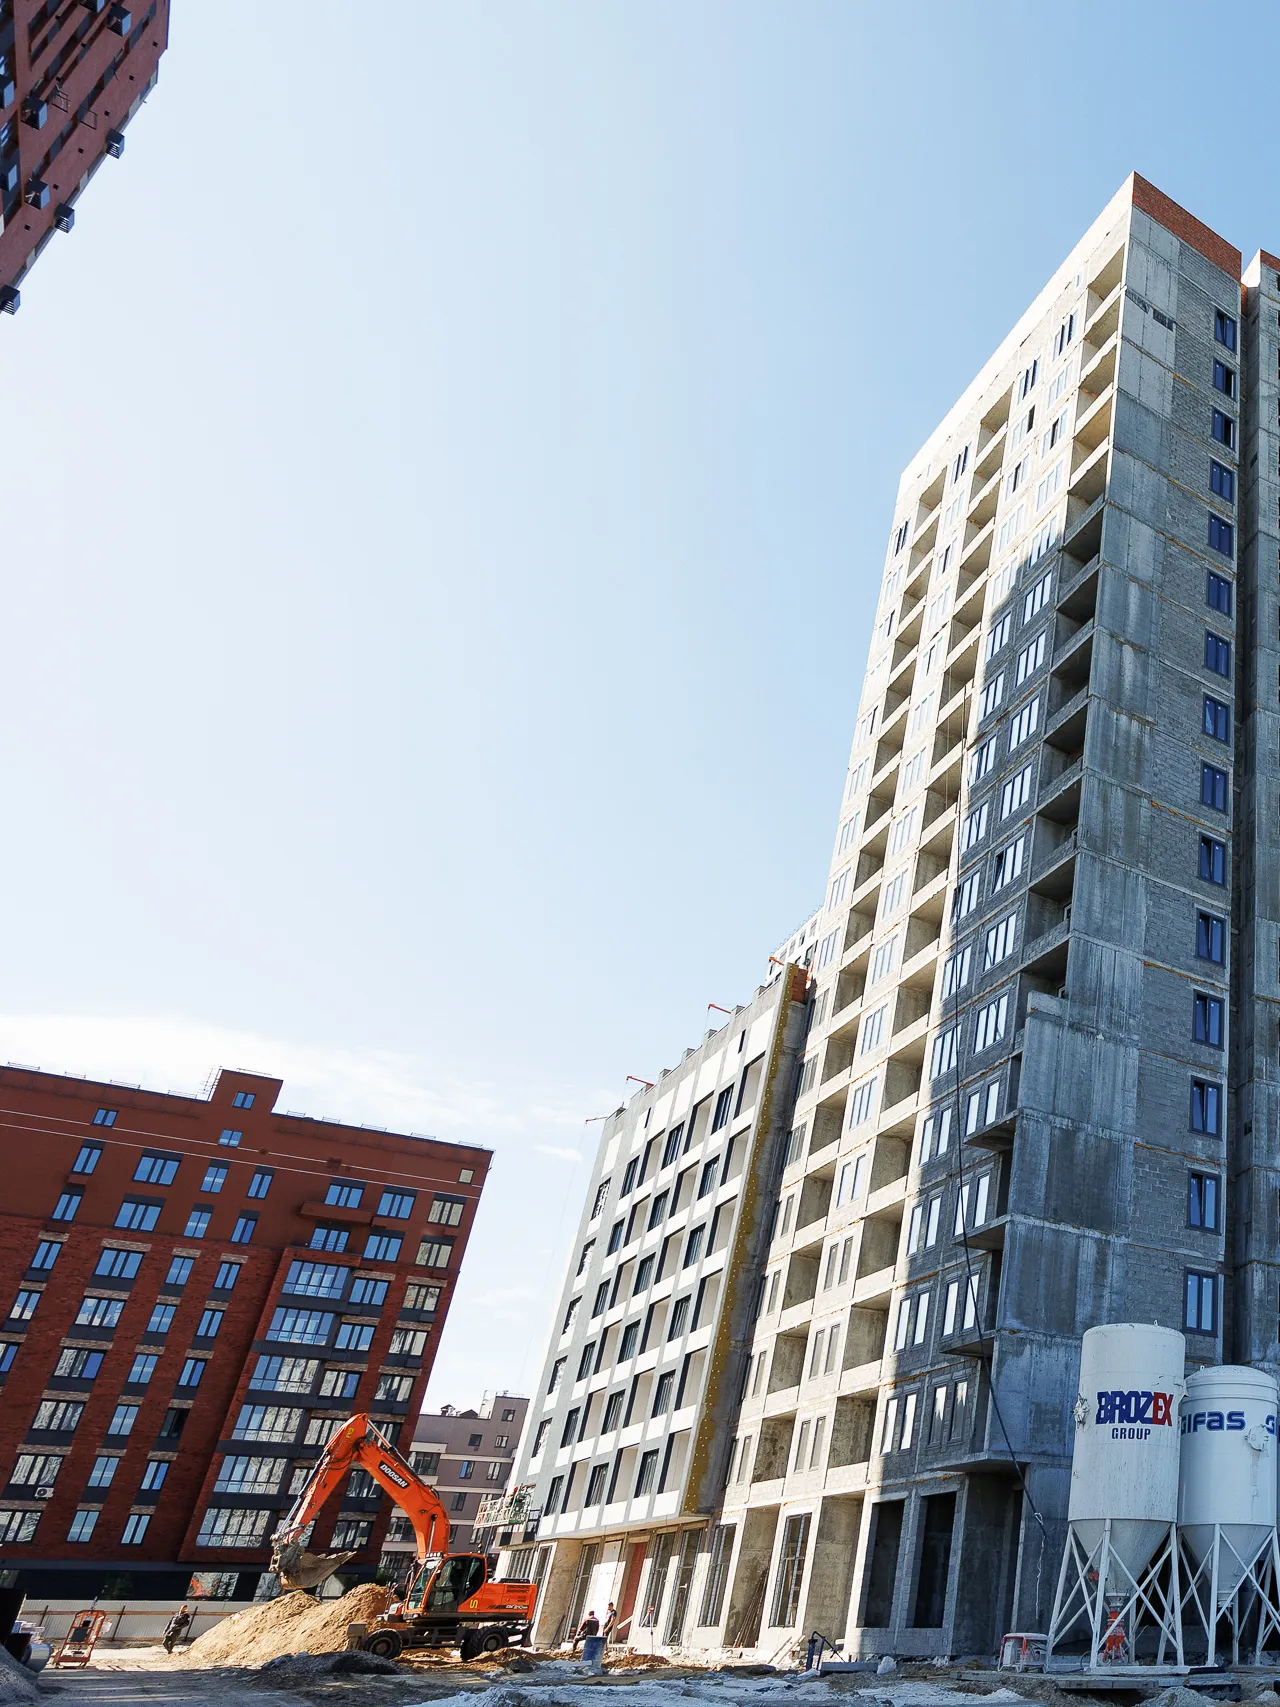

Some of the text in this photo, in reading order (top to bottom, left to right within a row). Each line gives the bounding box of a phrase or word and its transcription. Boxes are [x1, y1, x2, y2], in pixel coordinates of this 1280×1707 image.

[1095, 1391, 1174, 1427] BROZEX
[1112, 1427, 1151, 1440] GROUP
[380, 1464, 408, 1488] DOOSAN
